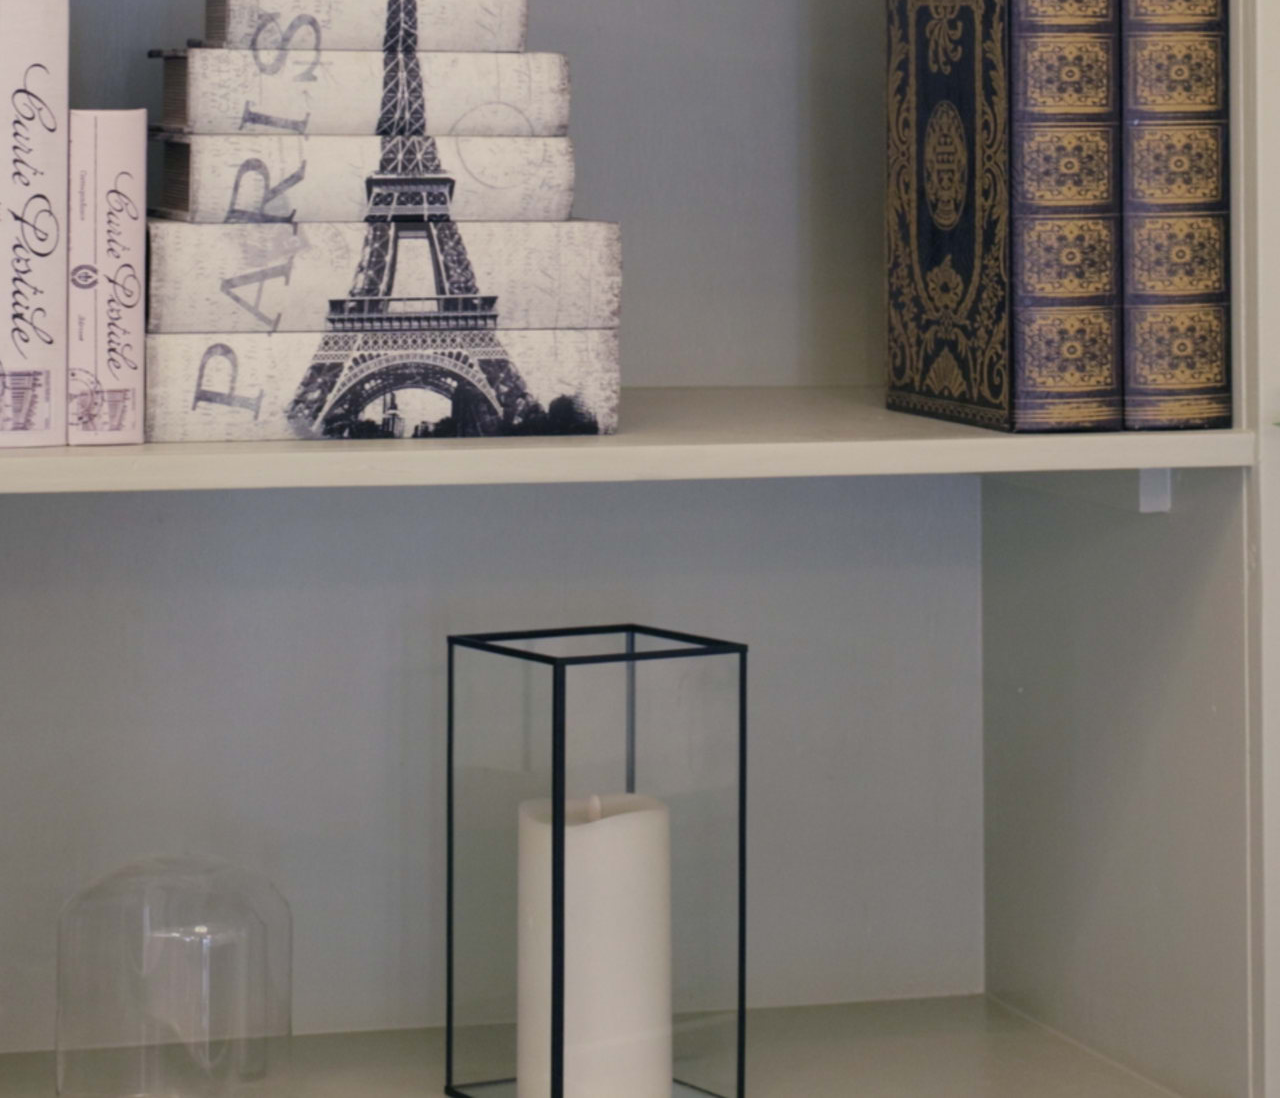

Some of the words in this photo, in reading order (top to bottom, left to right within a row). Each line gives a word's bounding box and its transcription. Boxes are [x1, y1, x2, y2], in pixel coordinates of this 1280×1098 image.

[10, 62, 58, 188] Carte
[7, 194, 60, 360] Postale
[106, 171, 140, 259] Carte
[191, 11, 323, 422] PARIS
[103, 263, 142, 381] Postale
